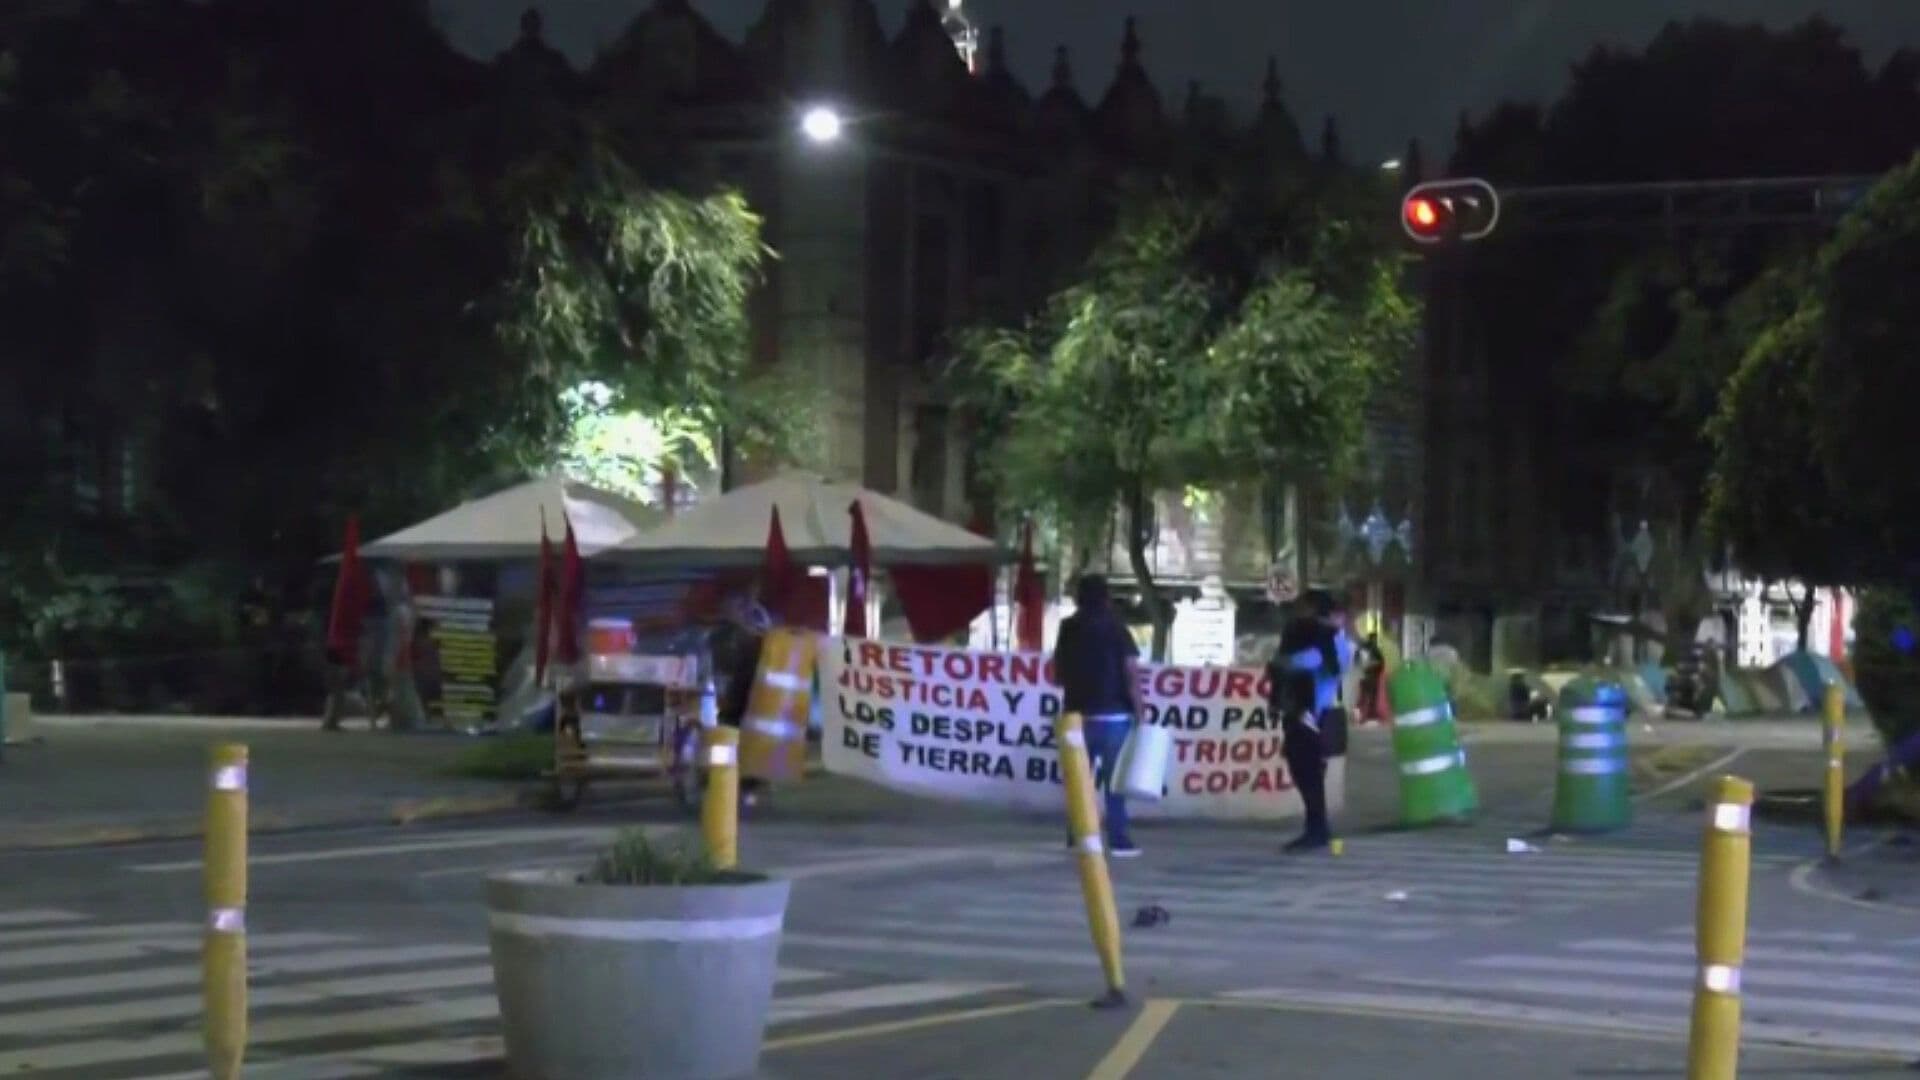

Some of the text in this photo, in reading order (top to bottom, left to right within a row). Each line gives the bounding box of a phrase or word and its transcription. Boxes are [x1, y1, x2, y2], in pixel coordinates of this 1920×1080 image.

[838, 669, 989, 713] JUSTICIA
[1002, 690, 1024, 715] Y
[839, 694, 1280, 764] LOS DESPLAZ TRIQU
[843, 726, 881, 759] DE
[897, 740, 1014, 780] TIERRA
[1026, 757, 1064, 784] BL
[1183, 767, 1293, 794] COPAL
